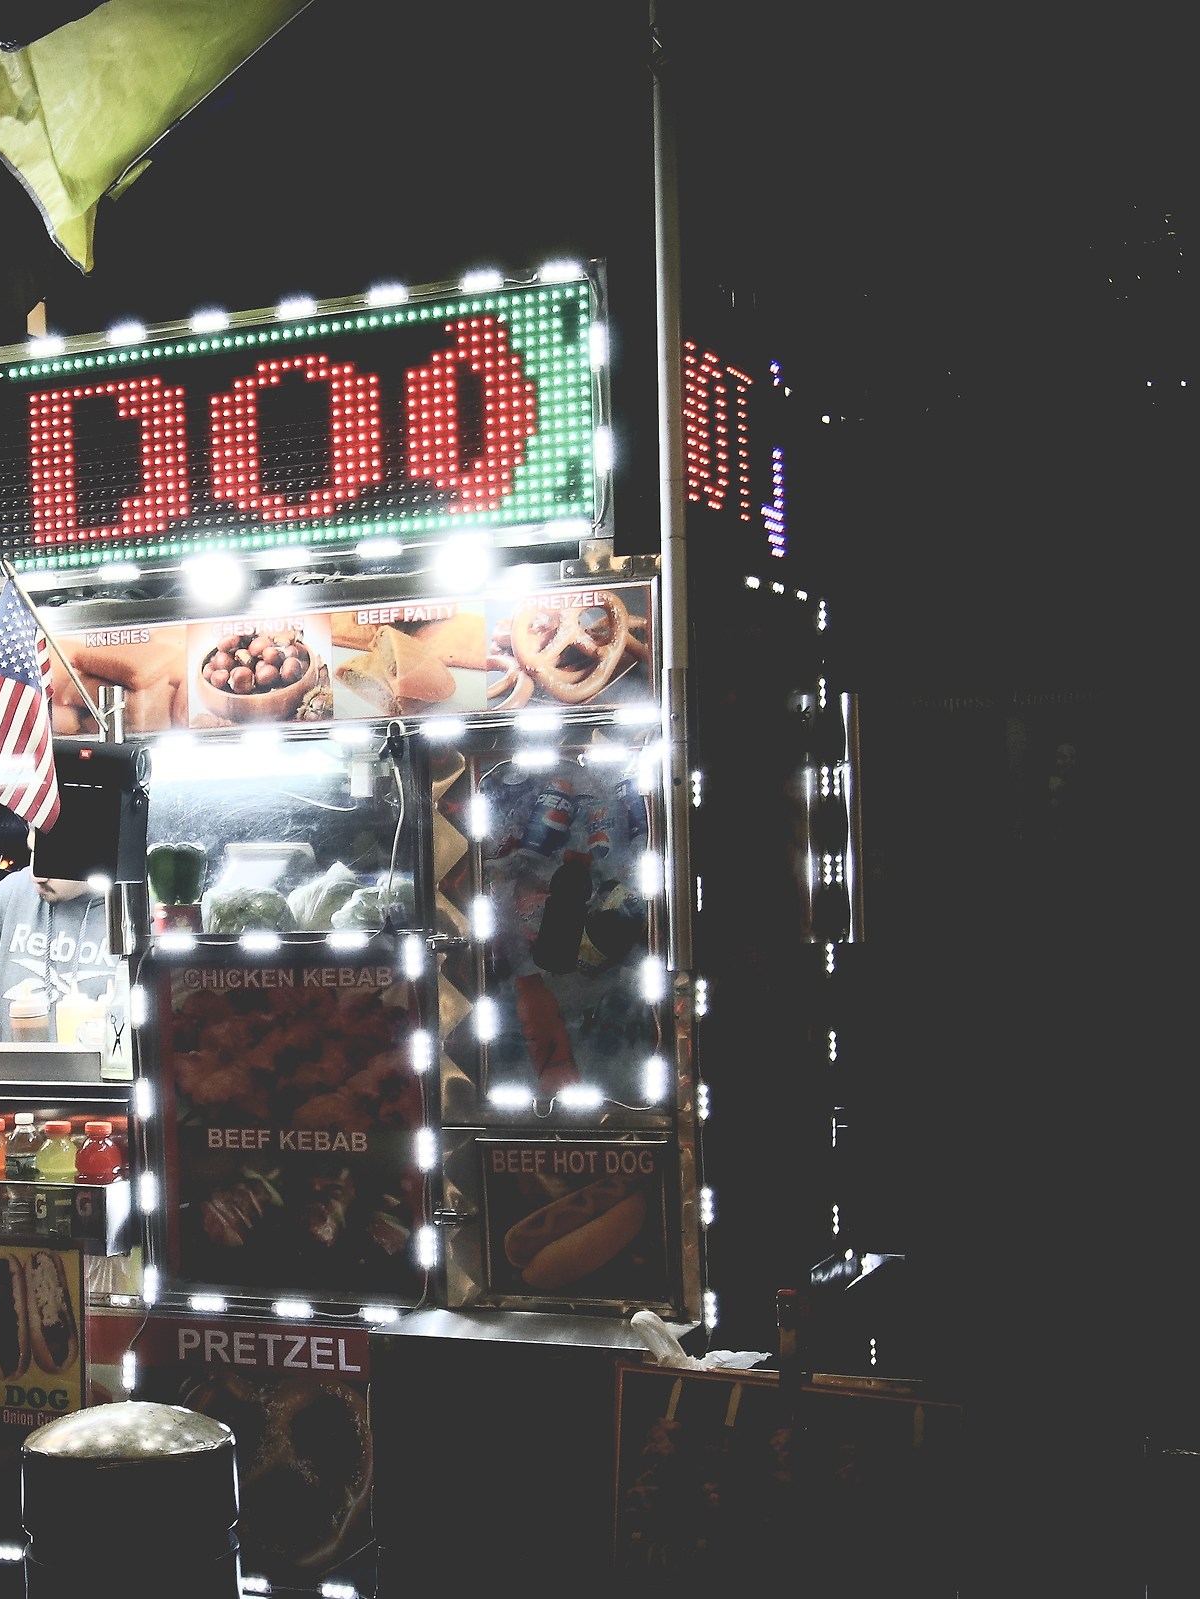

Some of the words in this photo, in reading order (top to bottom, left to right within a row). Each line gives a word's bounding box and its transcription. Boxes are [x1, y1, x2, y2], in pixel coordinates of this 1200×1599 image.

[527, 591, 605, 611] PRETZEL
[357, 607, 399, 625] BEEF
[403, 603, 456, 622] PATTY
[86, 628, 151, 648] KNISHES
[183, 968, 294, 988] CHICKEN
[303, 966, 393, 987] KEBAB
[207, 1128, 270, 1149] BEEF
[279, 1130, 368, 1152] KEBAB
[493, 1149, 546, 1174] BEEF
[553, 1150, 599, 1174] HOT
[605, 1150, 656, 1175] DOG
[177, 1327, 362, 1372] PRETZEL
[5, 1385, 70, 1410] DOG
[3, 1409, 33, 1426] Onion
